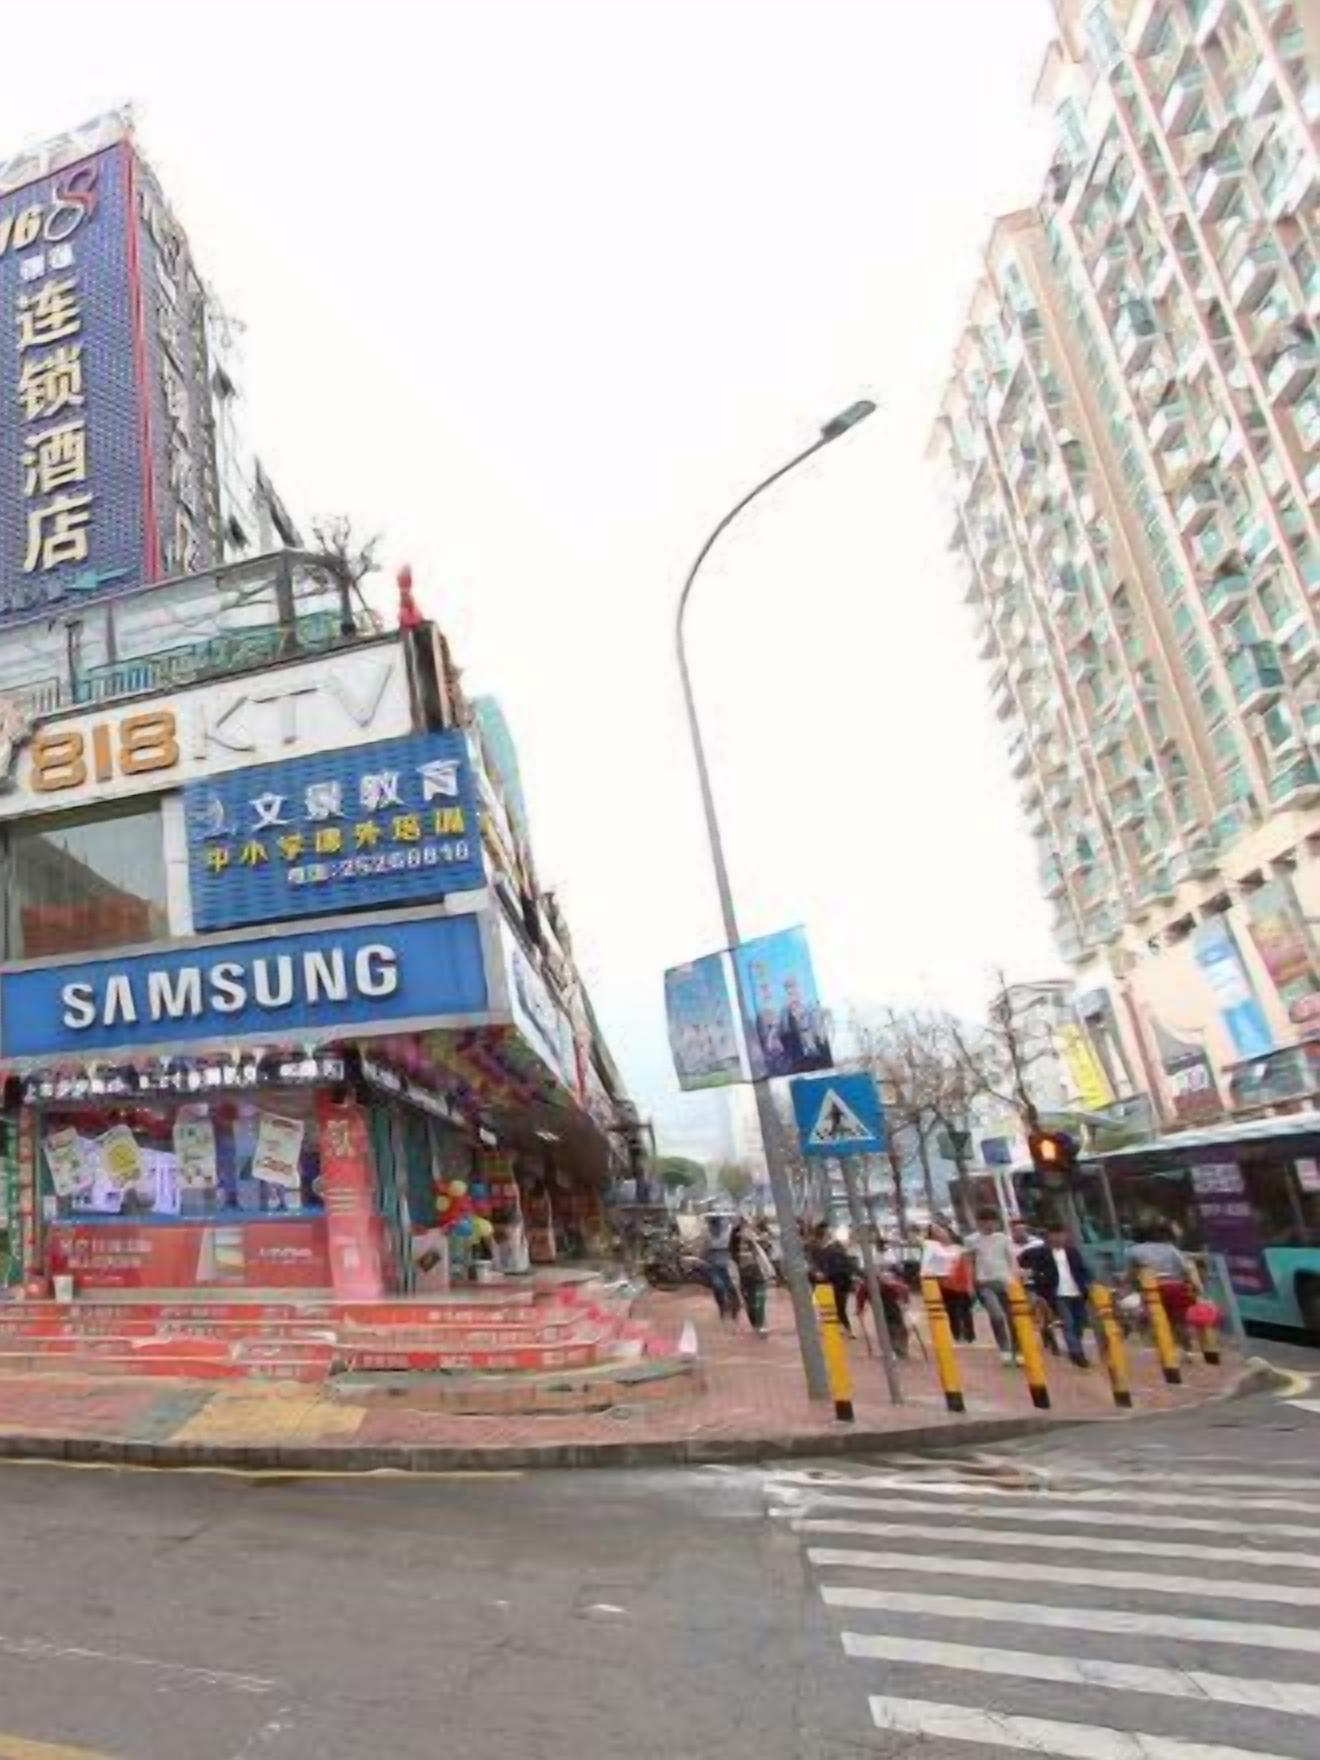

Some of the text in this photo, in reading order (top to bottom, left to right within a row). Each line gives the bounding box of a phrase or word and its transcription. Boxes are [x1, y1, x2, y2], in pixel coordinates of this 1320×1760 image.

[15, 277, 91, 572] 连锁酒店
[29, 661, 397, 795] 818 KTV
[61, 942, 400, 1030] SAMSUNG
